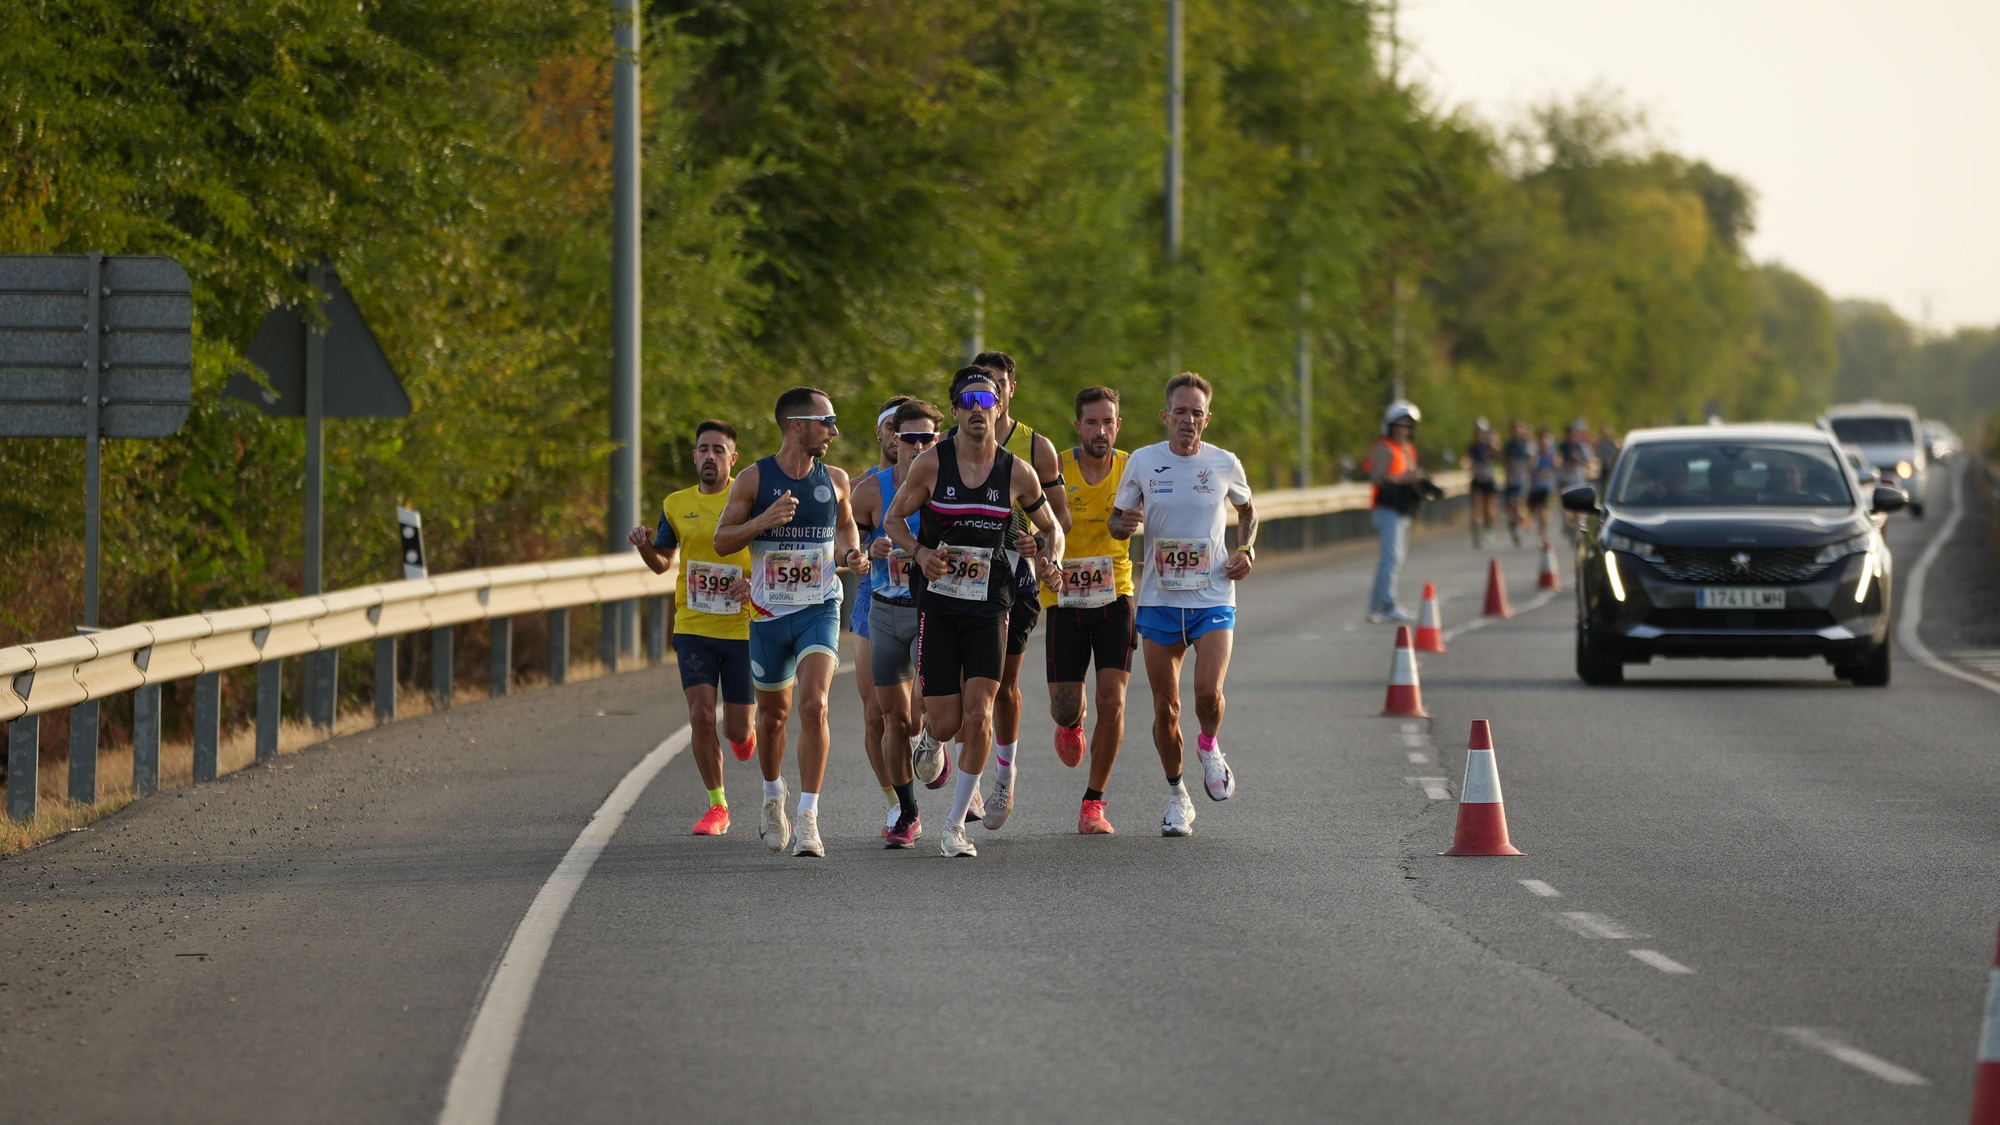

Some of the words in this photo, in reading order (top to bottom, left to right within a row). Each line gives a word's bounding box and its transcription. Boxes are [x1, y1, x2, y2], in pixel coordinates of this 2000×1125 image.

[771, 526, 834, 539] MOSQUETEROS
[1165, 551, 1199, 567] 495
[777, 566, 812, 584] 598
[947, 558, 979, 578] 586
[698, 575, 730, 592] 399
[1069, 569, 1103, 587] 494
[1709, 591, 1746, 606] 1741
